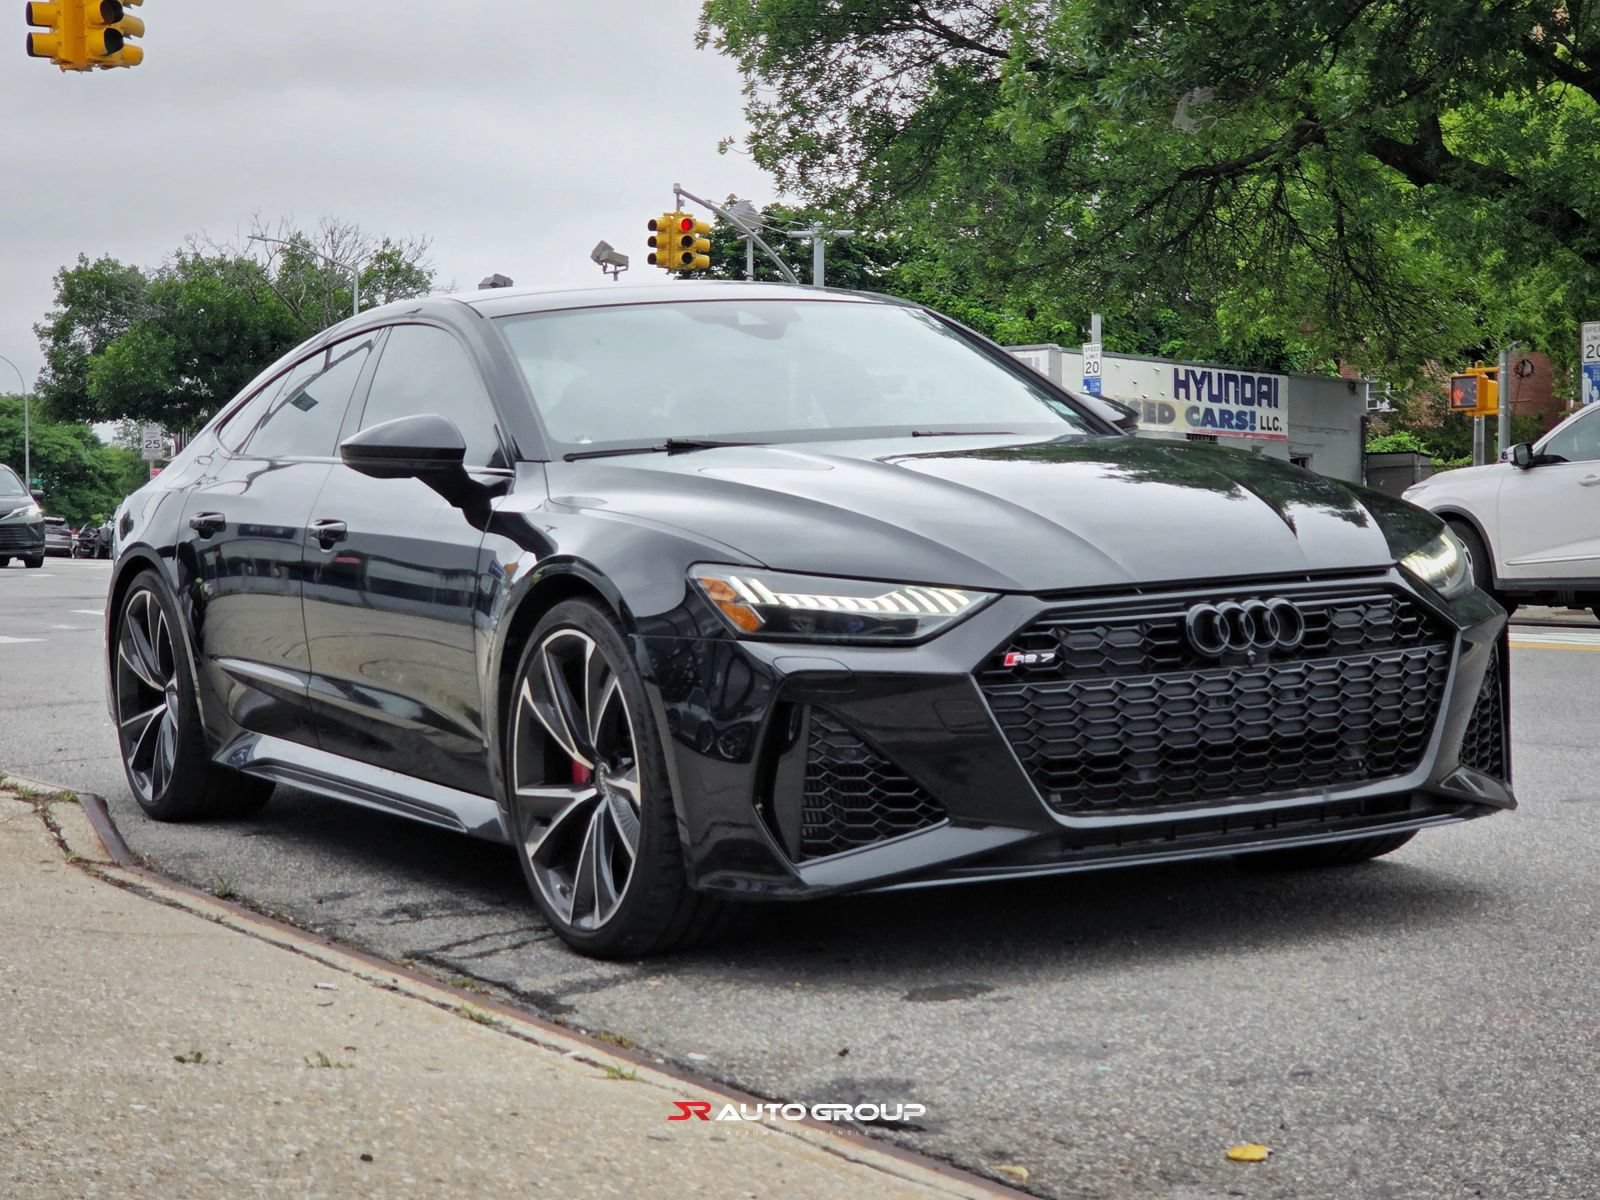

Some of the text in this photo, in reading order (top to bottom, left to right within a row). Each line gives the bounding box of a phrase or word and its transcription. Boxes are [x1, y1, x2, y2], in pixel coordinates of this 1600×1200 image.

[1085, 361, 1100, 374] 20
[1174, 367, 1279, 409] HYUNDAI
[1128, 400, 1282, 431] ED CARS! LLC.
[145, 440, 161, 449] 25
